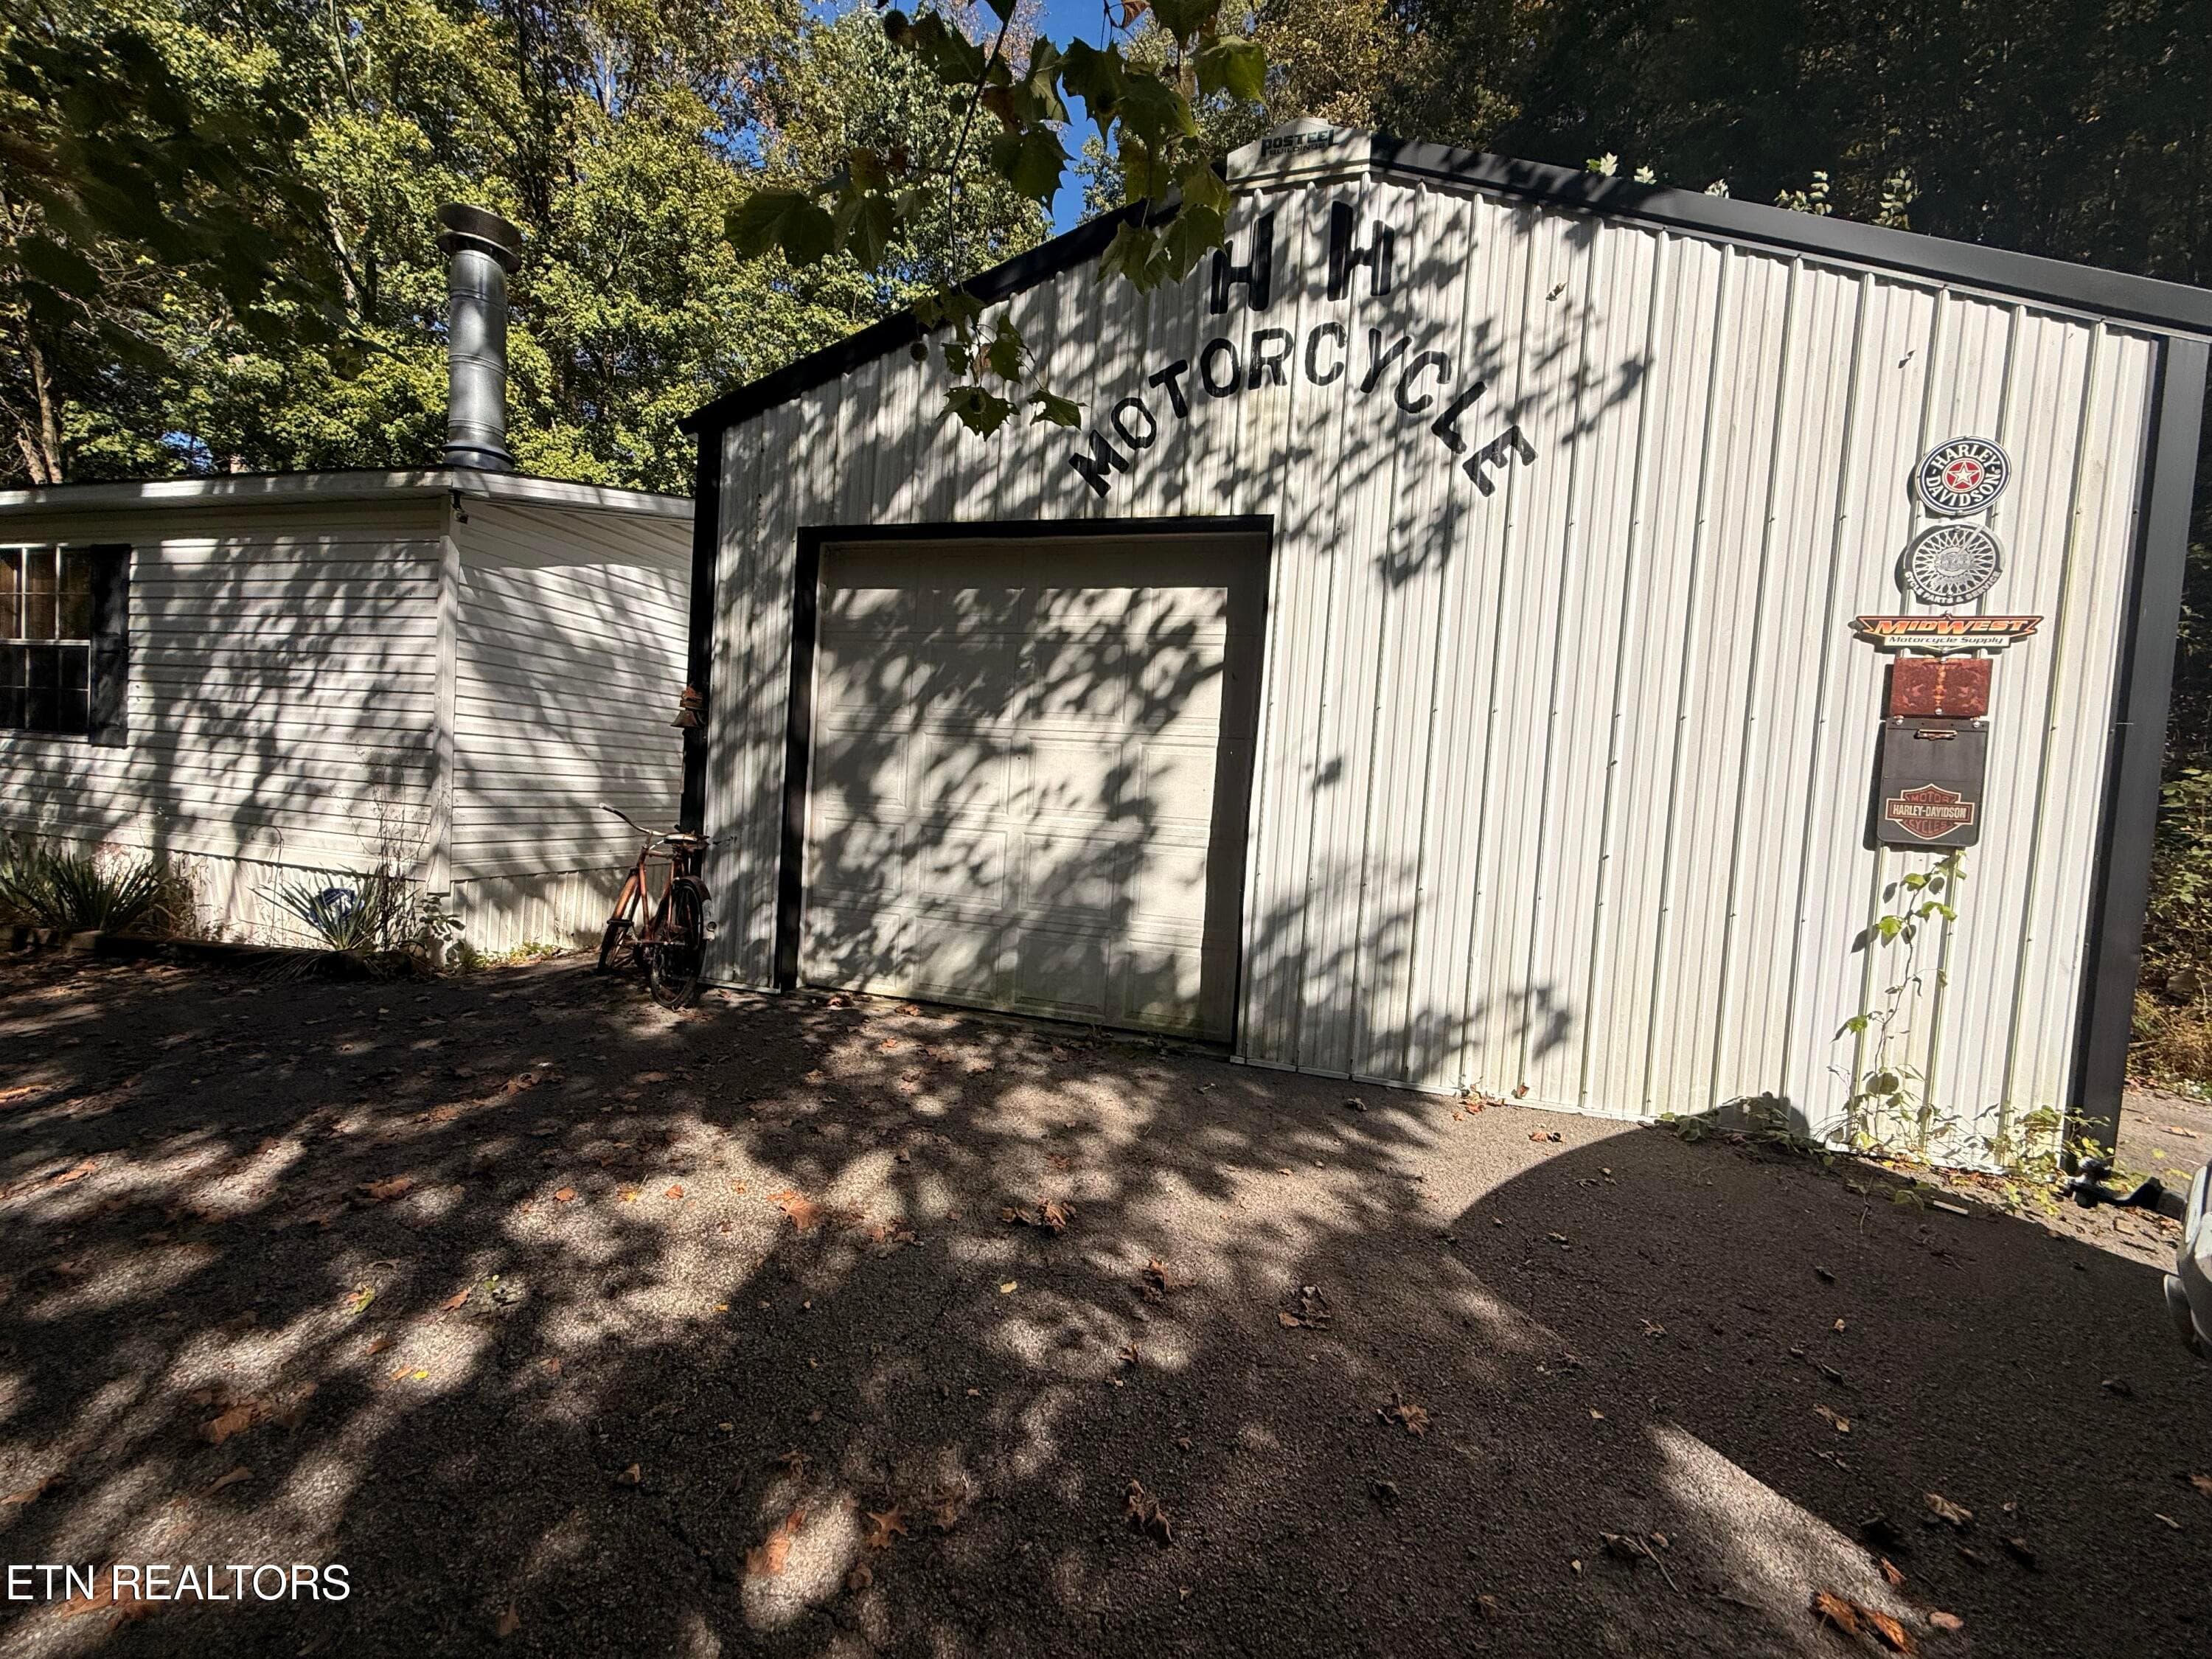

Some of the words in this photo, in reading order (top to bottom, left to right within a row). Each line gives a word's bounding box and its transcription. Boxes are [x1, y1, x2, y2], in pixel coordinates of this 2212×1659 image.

[1068, 321, 1537, 498] MOTORCYCLE
[1926, 473, 2001, 507] DAVIDSON
[1905, 571, 1924, 597] CYCLE
[1922, 593, 1954, 604] PARTS
[1912, 792, 1950, 803] MOTOR
[1893, 804, 1966, 818] HARLEY-DAVIDSON
[1908, 819, 1947, 834] CYCLES
